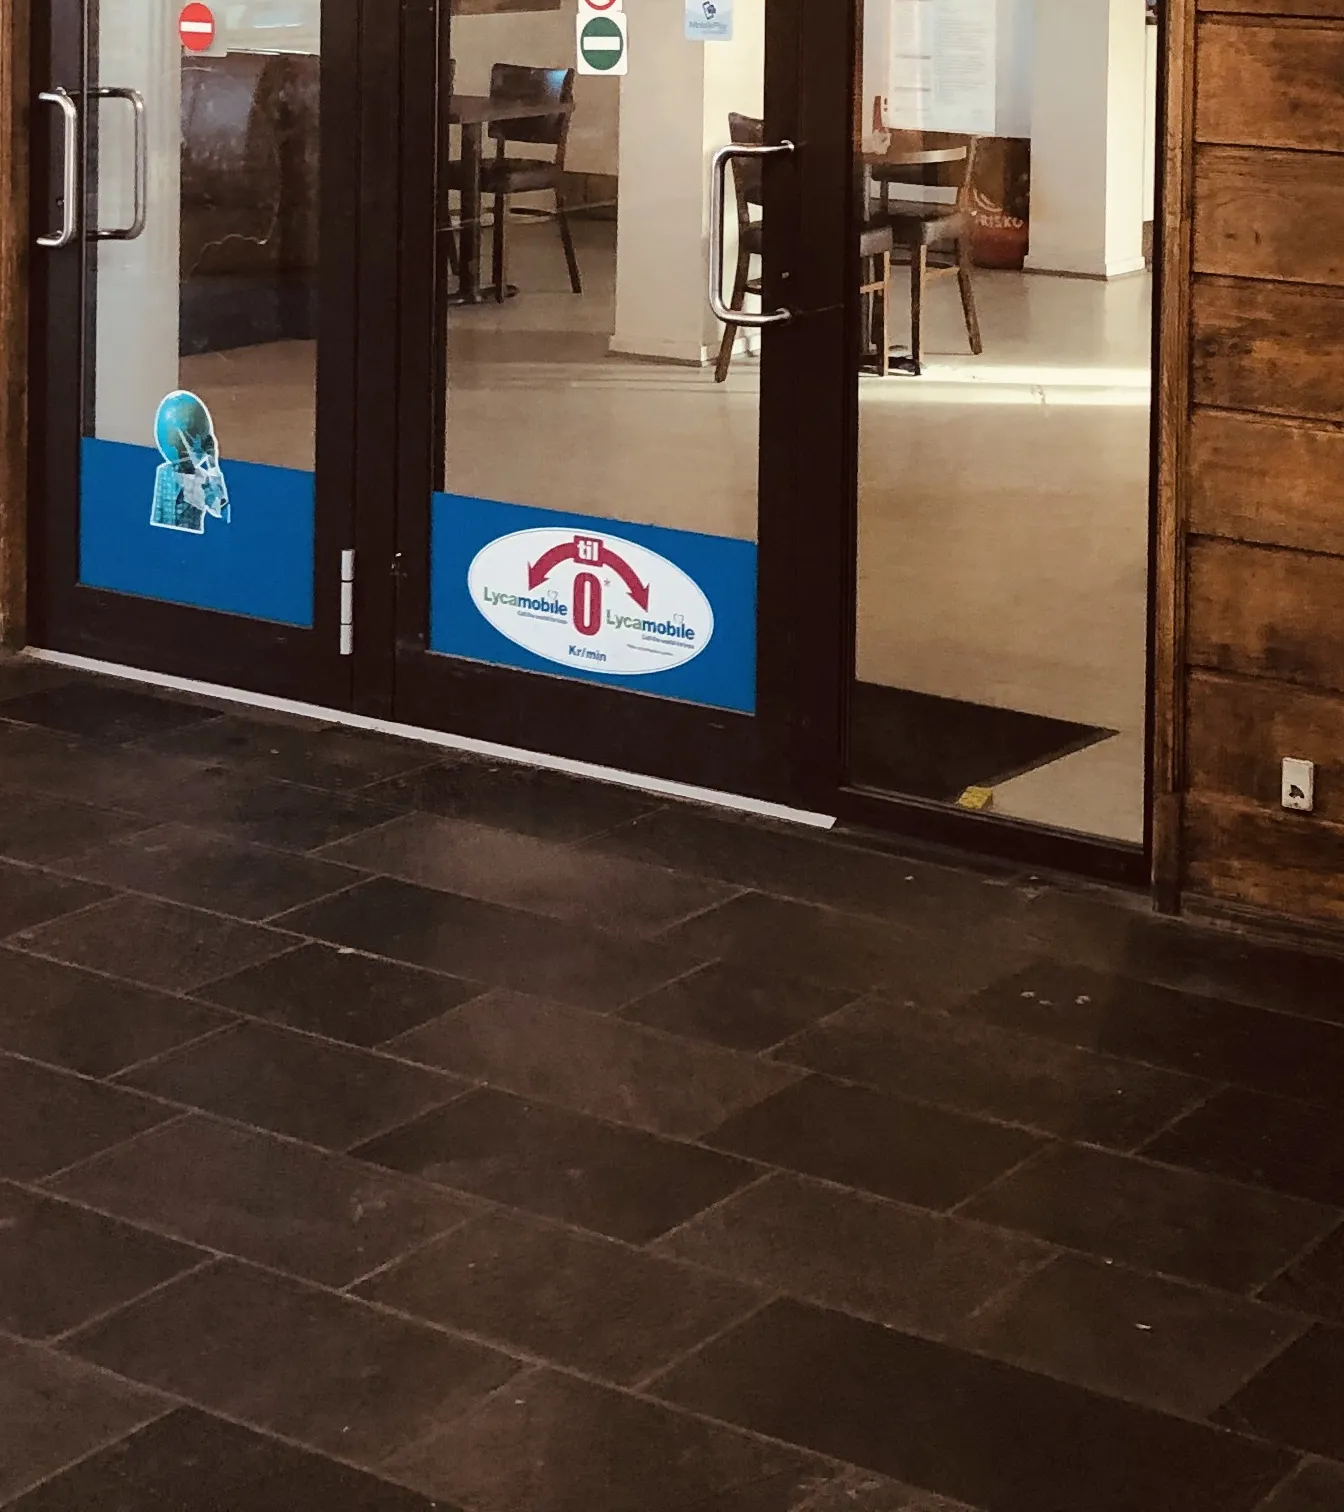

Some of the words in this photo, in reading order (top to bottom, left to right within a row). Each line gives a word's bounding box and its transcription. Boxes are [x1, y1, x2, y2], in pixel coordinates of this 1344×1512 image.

[577, 540, 599, 561] til
[483, 586, 568, 616] Lycamobile
[606, 609, 695, 640] Lycamobile
[568, 644, 607, 662] Kr/min
